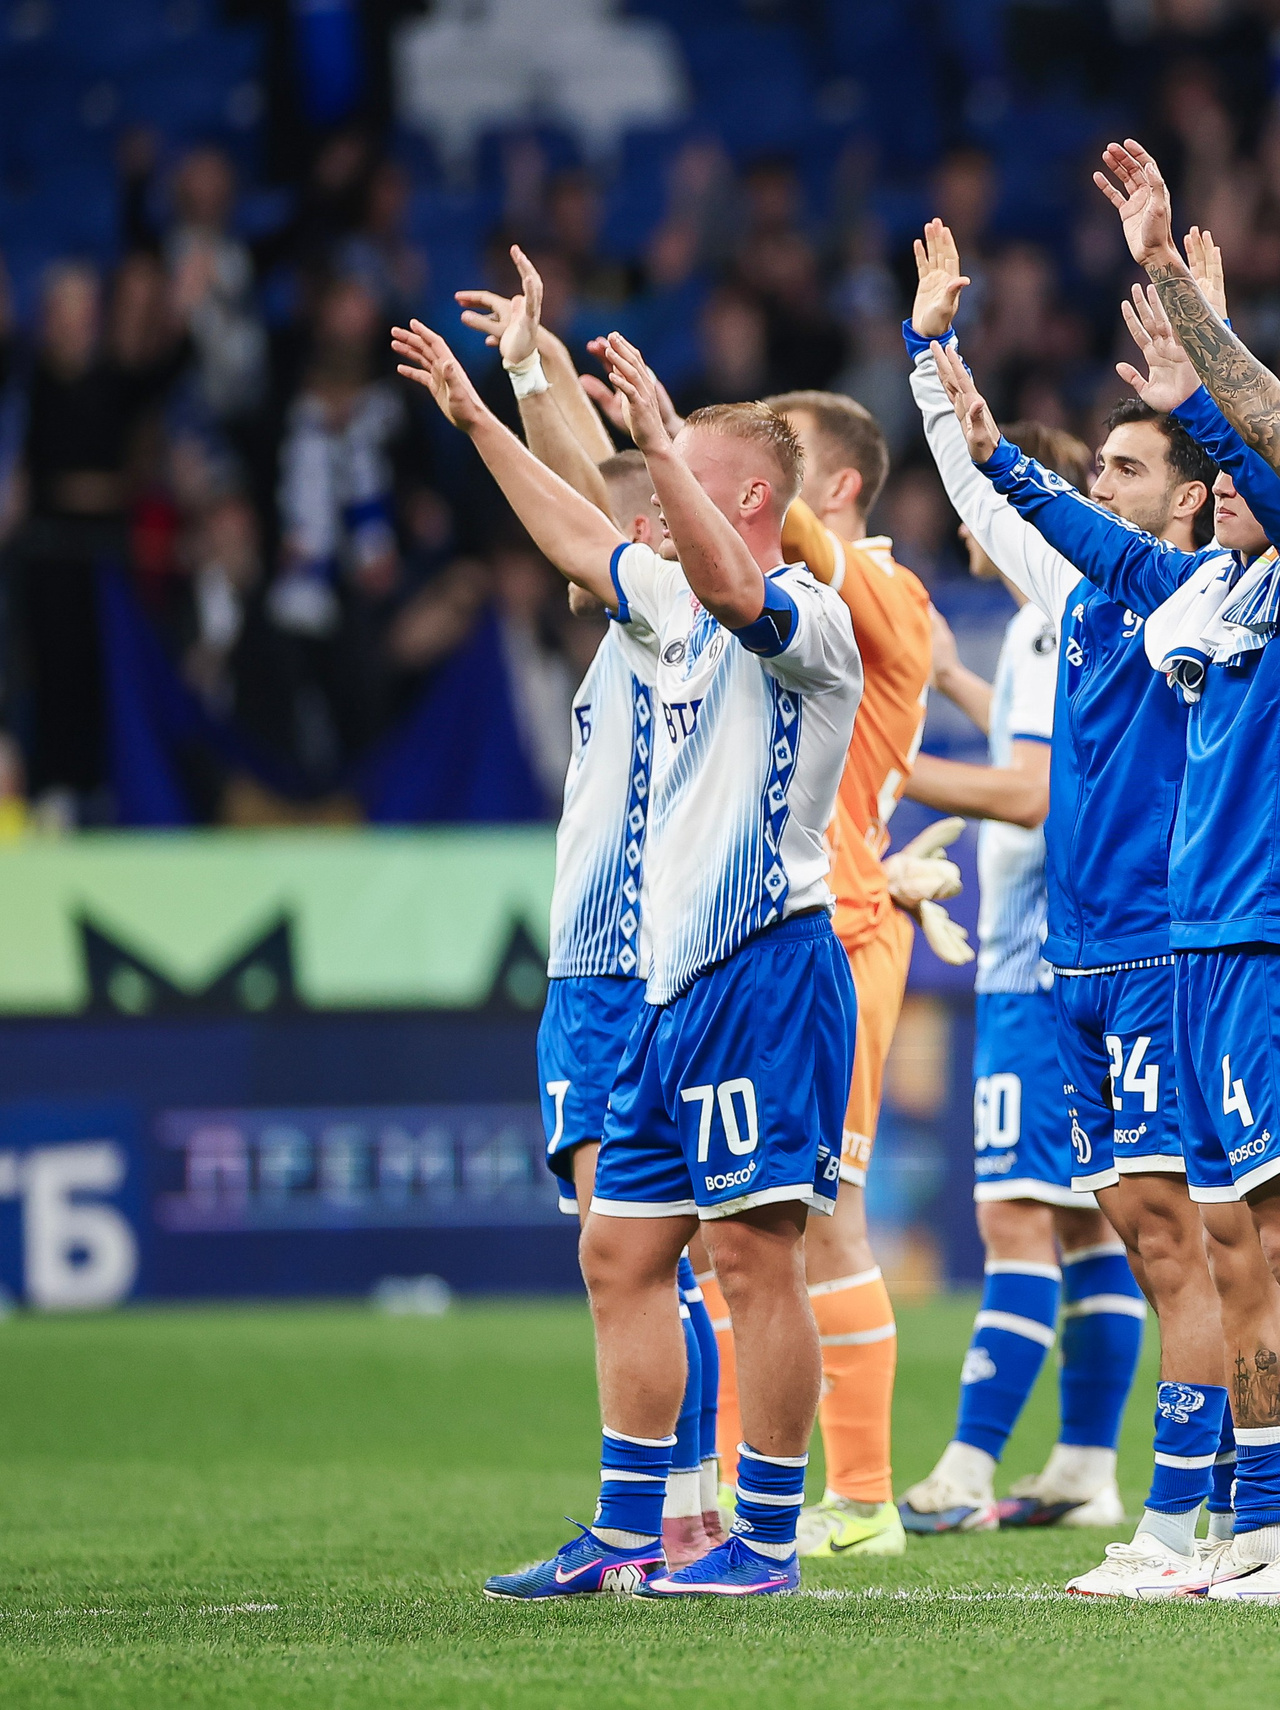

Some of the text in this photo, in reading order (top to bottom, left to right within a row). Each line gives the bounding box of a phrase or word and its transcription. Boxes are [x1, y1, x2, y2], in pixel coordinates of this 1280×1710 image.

[1105, 1036, 1160, 1112] 24
[1221, 1054, 1255, 1127] 4
[545, 1080, 571, 1154] 7
[680, 1077, 760, 1163] 70
[1228, 1139, 1266, 1167] BOSCO
[704, 1169, 752, 1192] BOSCO
